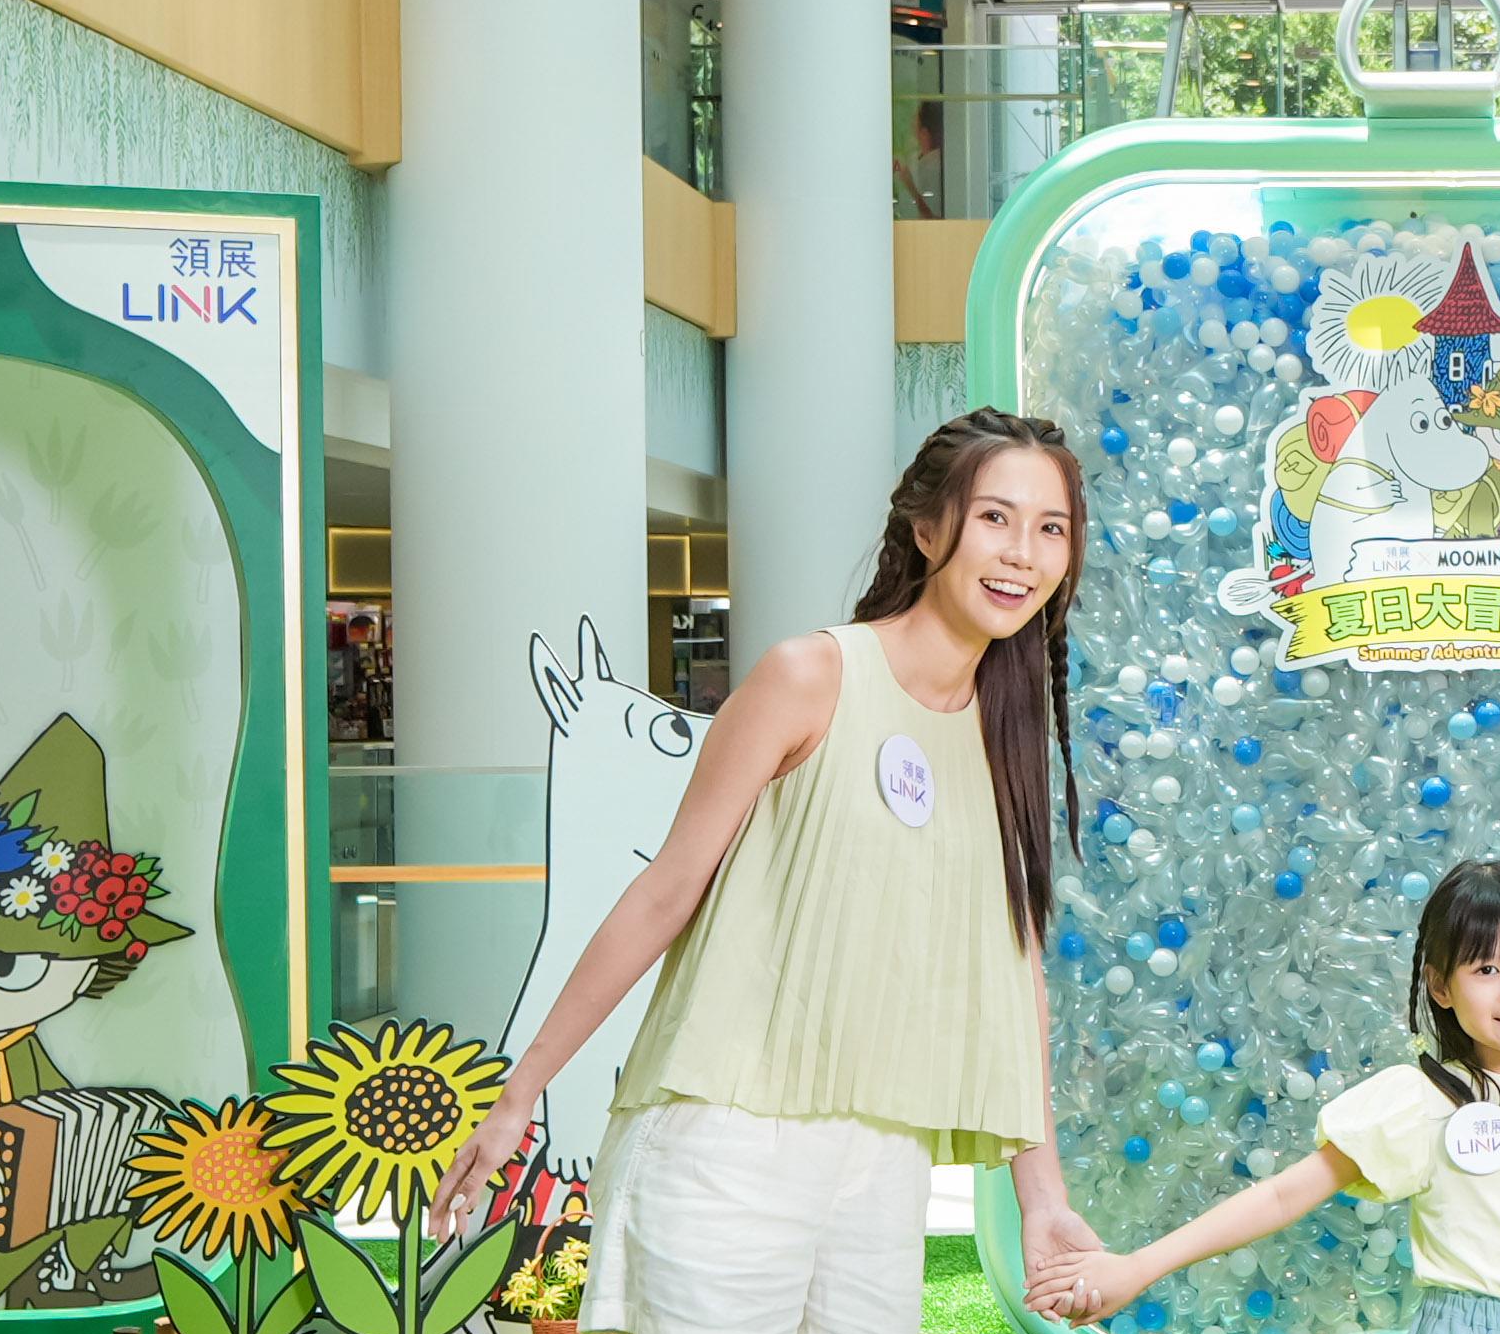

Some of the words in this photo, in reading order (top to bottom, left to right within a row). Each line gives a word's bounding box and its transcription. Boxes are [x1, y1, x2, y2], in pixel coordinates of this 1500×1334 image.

[169, 237, 257, 278] 領展
[122, 282, 257, 325] LINK
[1372, 560, 1412, 572] LINK
[1358, 645, 1429, 662] Summer
[889, 772, 927, 807] LINK
